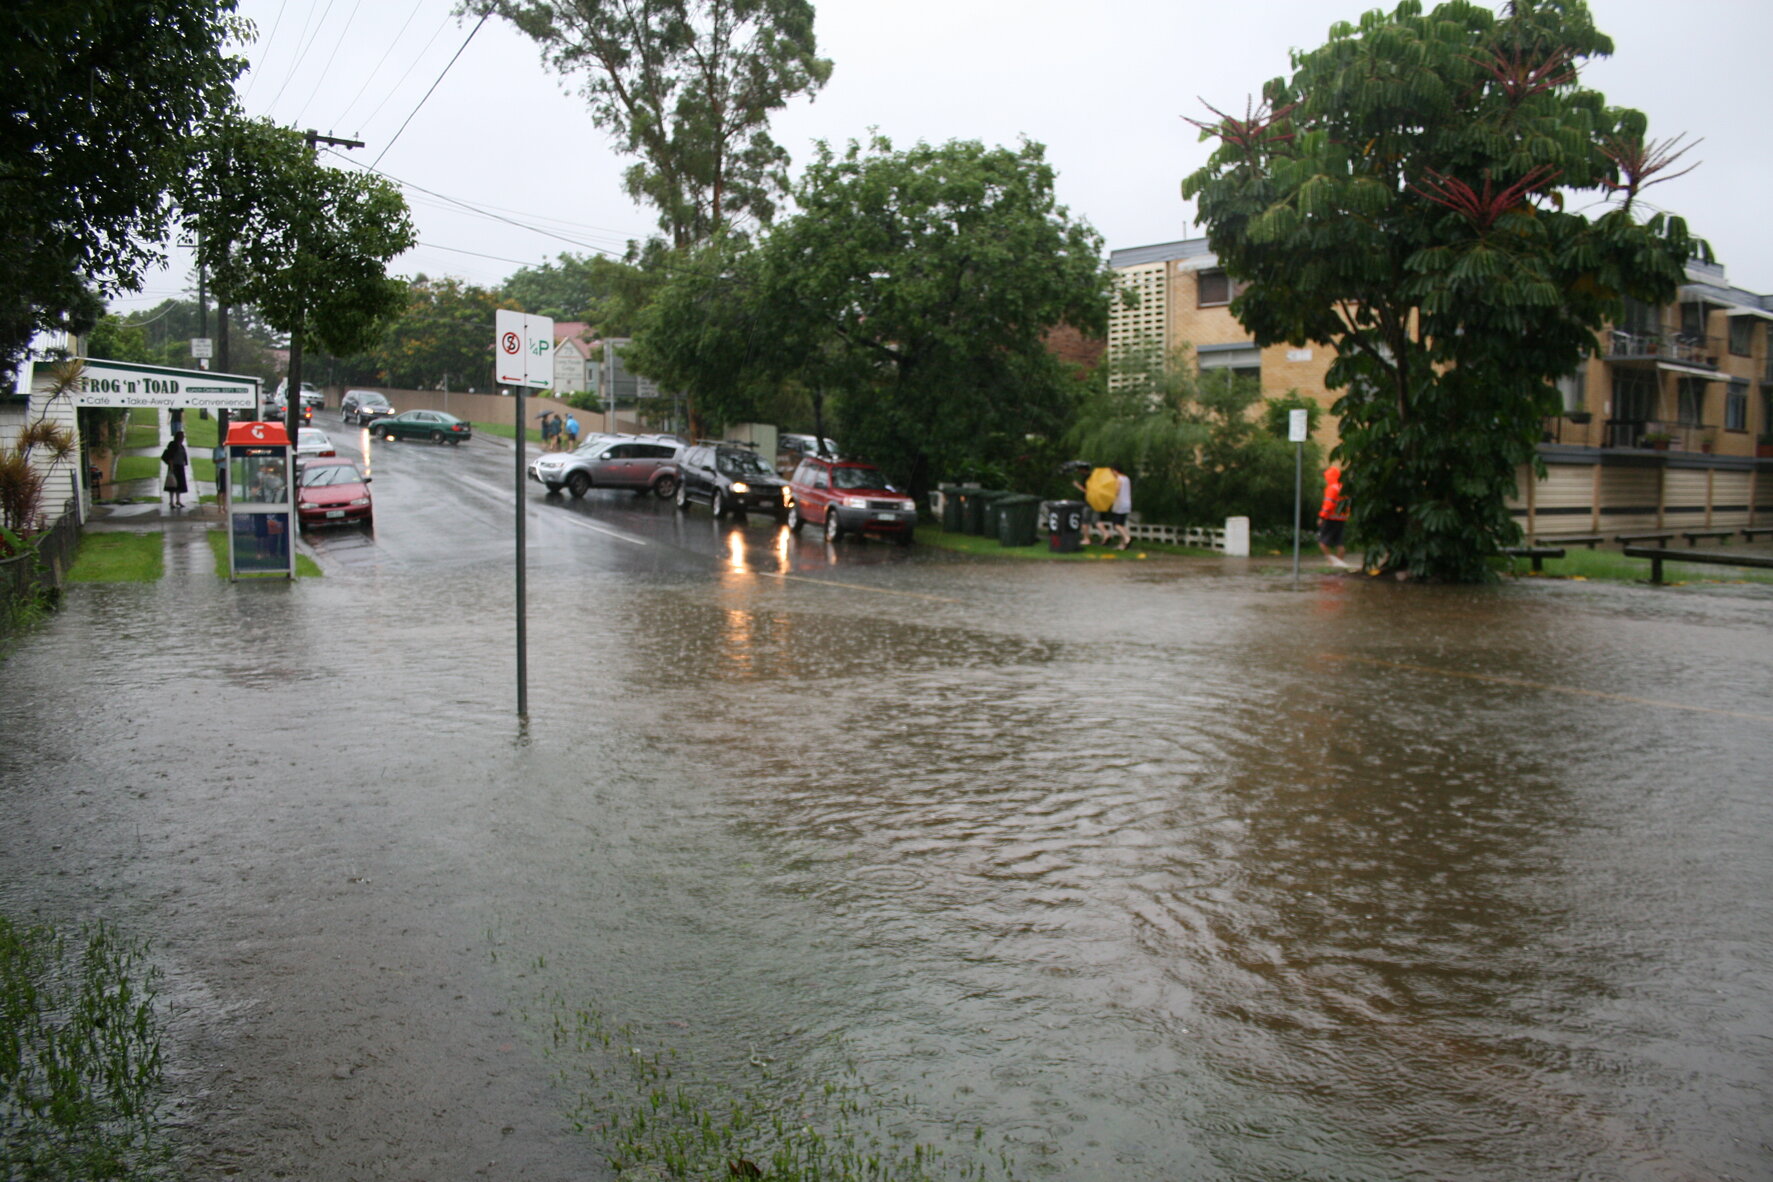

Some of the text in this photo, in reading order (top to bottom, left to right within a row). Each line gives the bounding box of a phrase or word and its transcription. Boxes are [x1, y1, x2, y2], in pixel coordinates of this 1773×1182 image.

[81, 376, 120, 393] FROG
[143, 378, 179, 393] TOAD
[191, 398, 251, 406] Convenience
[1069, 513, 1080, 530] 6
